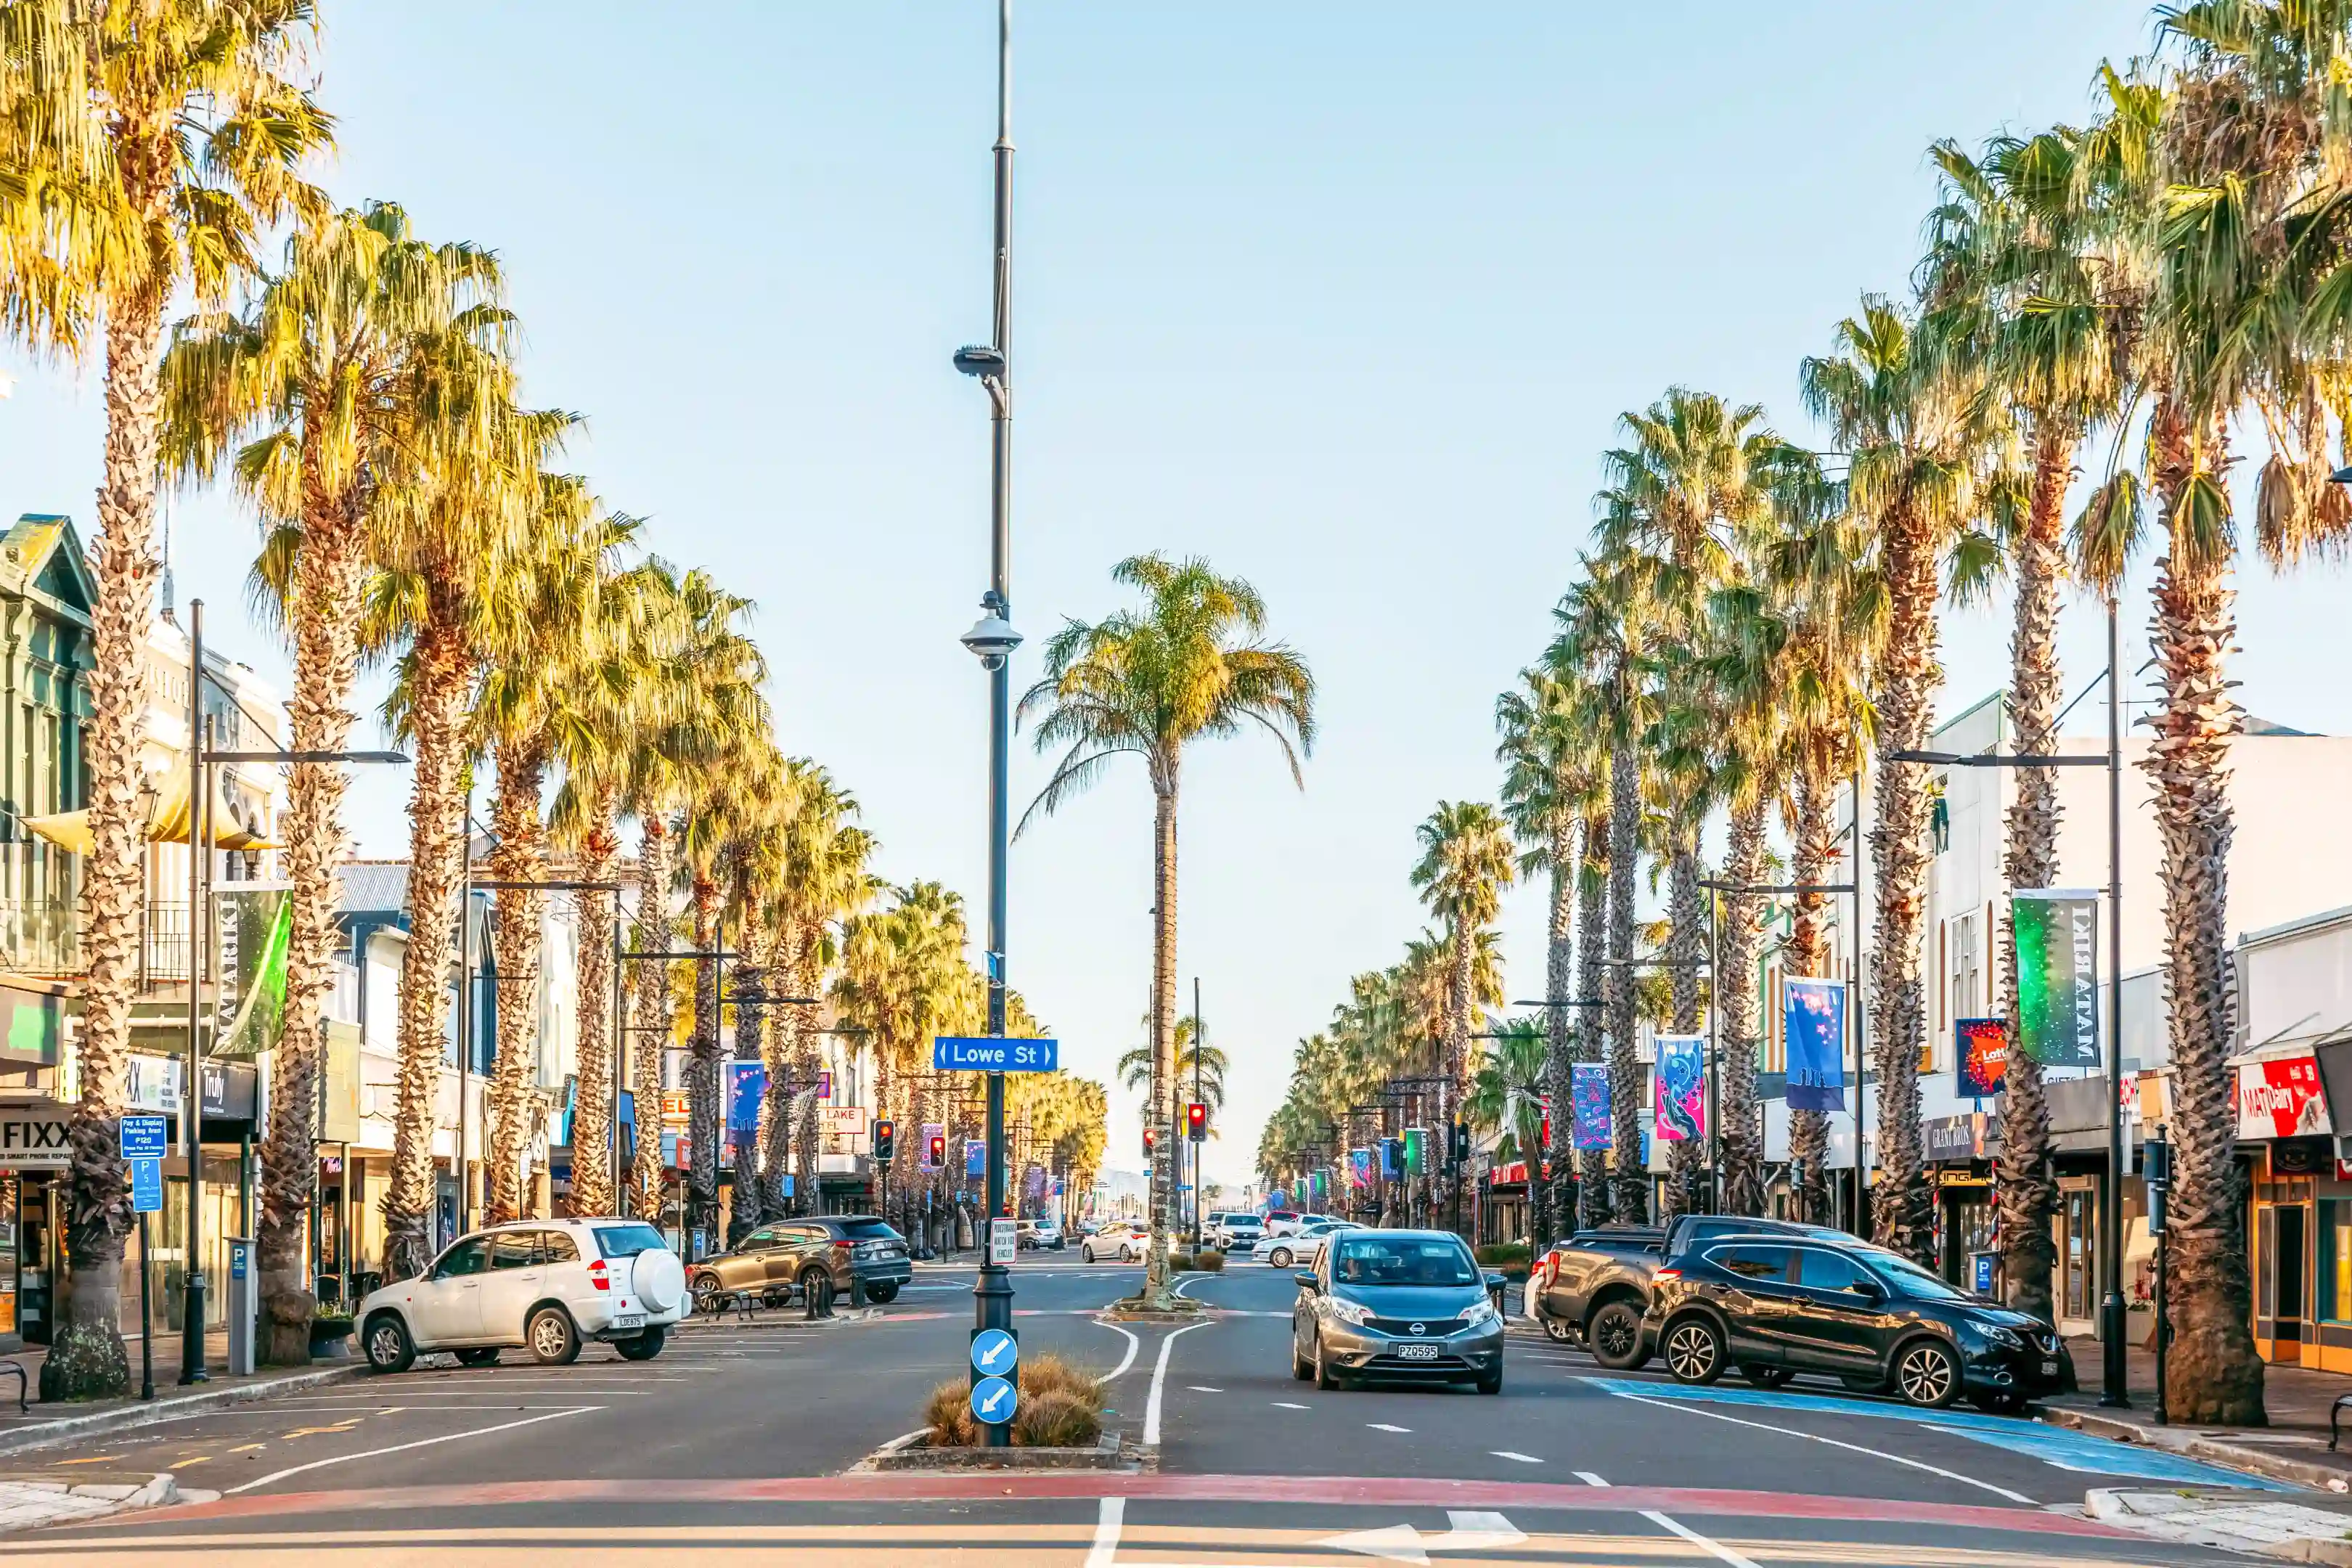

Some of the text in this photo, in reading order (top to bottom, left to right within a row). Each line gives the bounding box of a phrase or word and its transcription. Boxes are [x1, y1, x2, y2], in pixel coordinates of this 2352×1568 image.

[954, 1045, 1037, 1063] Lowe St
[1983, 1048, 2006, 1060] Lott
[204, 1069, 224, 1105] Truly
[826, 1110, 855, 1119] LAKE
[4, 1122, 72, 1148] FIXX
[1953, 1125, 1971, 1146] BROS.
[234, 1248, 244, 1262] P
[1979, 1262, 1989, 1273] P
[1400, 1347, 1437, 1356] PZQ595
